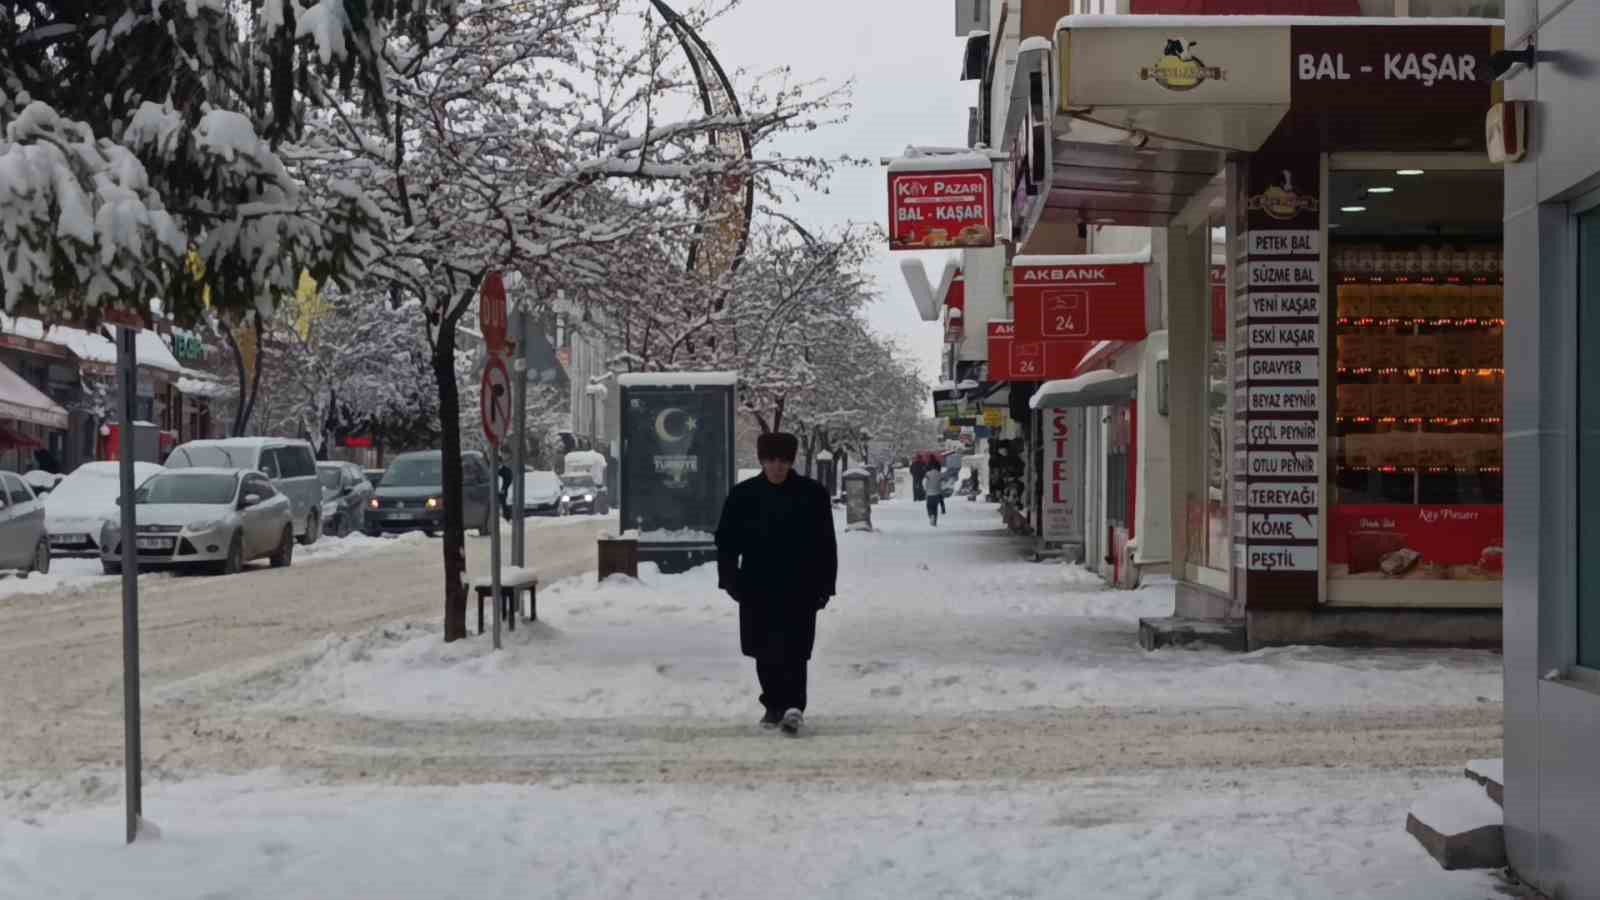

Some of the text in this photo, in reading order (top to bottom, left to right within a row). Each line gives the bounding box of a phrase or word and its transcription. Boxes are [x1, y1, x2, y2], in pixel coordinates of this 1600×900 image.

[1298, 53, 1350, 80] BAL
[1384, 52, 1476, 87] KAŞAR
[899, 207, 924, 220] BAL
[936, 205, 983, 222] KAŞAR
[1256, 235, 1312, 250] PETEK BAL
[1023, 269, 1105, 280] AKBANK
[1253, 265, 1314, 282] SÜZME BAL
[1253, 295, 1317, 315] YENİ KAŞAR
[1056, 316, 1074, 330] 24
[1252, 326, 1315, 346] ESKİ KAŞAR
[1020, 361, 1034, 372] 24
[1253, 361, 1302, 375] GRAVYER
[1252, 390, 1315, 408] BEYAZ PEYNİR
[1253, 458, 1277, 473] OTLU
[1252, 486, 1315, 504] TEREYAĞI
[1252, 549, 1295, 571] PEŞTİL
